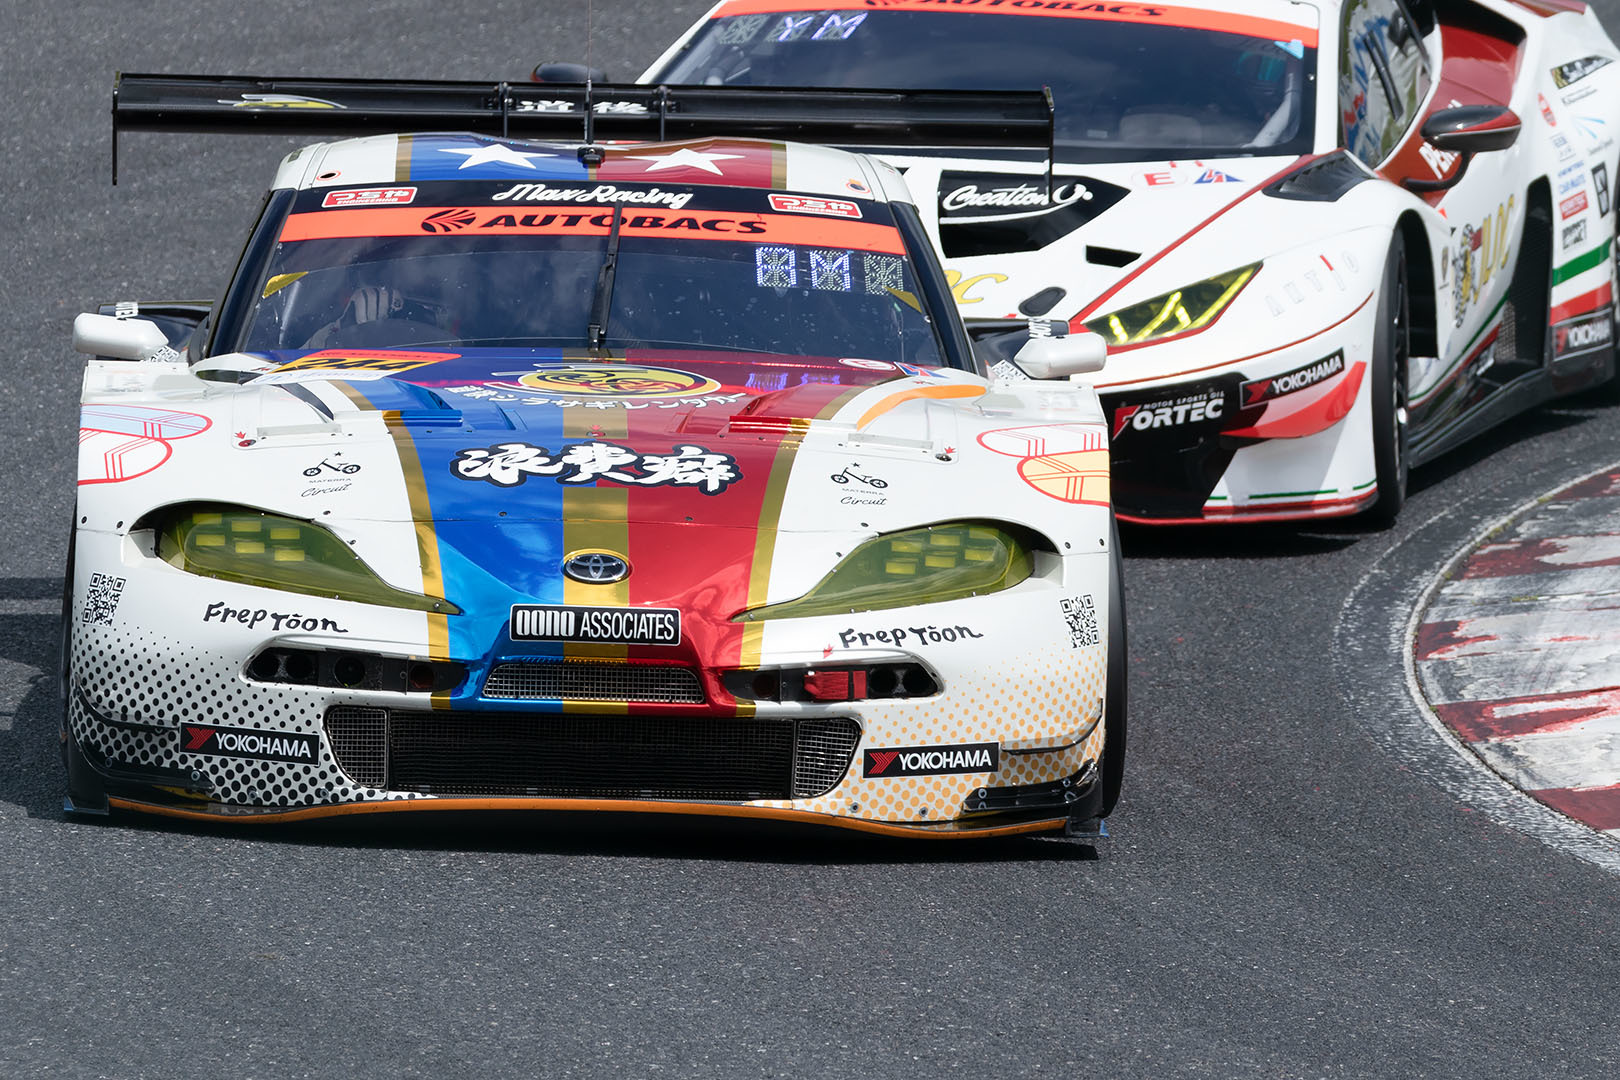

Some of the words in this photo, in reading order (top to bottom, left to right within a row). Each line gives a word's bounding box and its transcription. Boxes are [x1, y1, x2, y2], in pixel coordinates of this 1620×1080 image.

[480, 213, 767, 235] AUTOBACS
[1272, 355, 1343, 394] YOKOHAMA
[301, 482, 352, 498] Circuit
[840, 496, 888, 506] Circuit
[580, 611, 675, 641] ASSOCIATES
[215, 732, 312, 758] YOKOHAMA
[898, 749, 992, 771] YOKOHAMA
